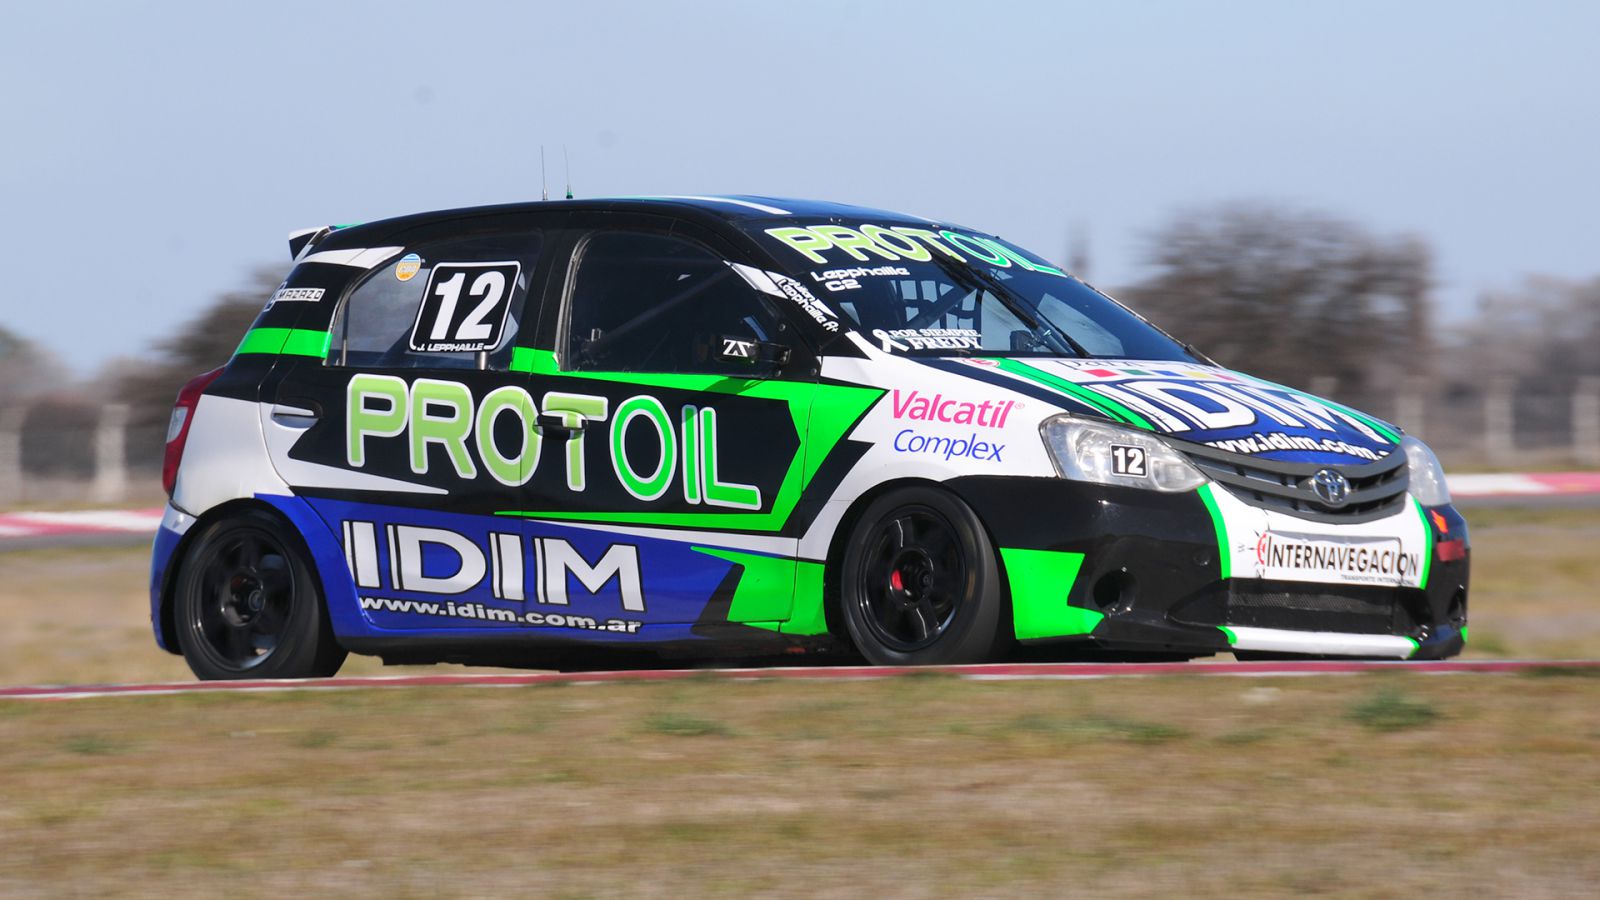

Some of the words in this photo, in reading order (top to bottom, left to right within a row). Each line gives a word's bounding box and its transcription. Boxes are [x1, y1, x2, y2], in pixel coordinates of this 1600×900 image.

[764, 224, 1067, 278] PROTOIL
[810, 266, 910, 281] Lepphaille
[824, 279, 862, 291] C2
[429, 271, 506, 341] 12
[888, 329, 921, 338] POR
[904, 336, 983, 349] FREDY
[893, 389, 1015, 428] Valcatil
[1080, 379, 1389, 444] IDIM
[346, 373, 762, 511] PROTOIL
[893, 429, 1005, 462] Complex
[1113, 447, 1144, 475] 12
[343, 520, 645, 612] IDIM
[1266, 535, 1418, 577] INTERNAVEGACION
[359, 597, 642, 633] www.idim.com.ar
